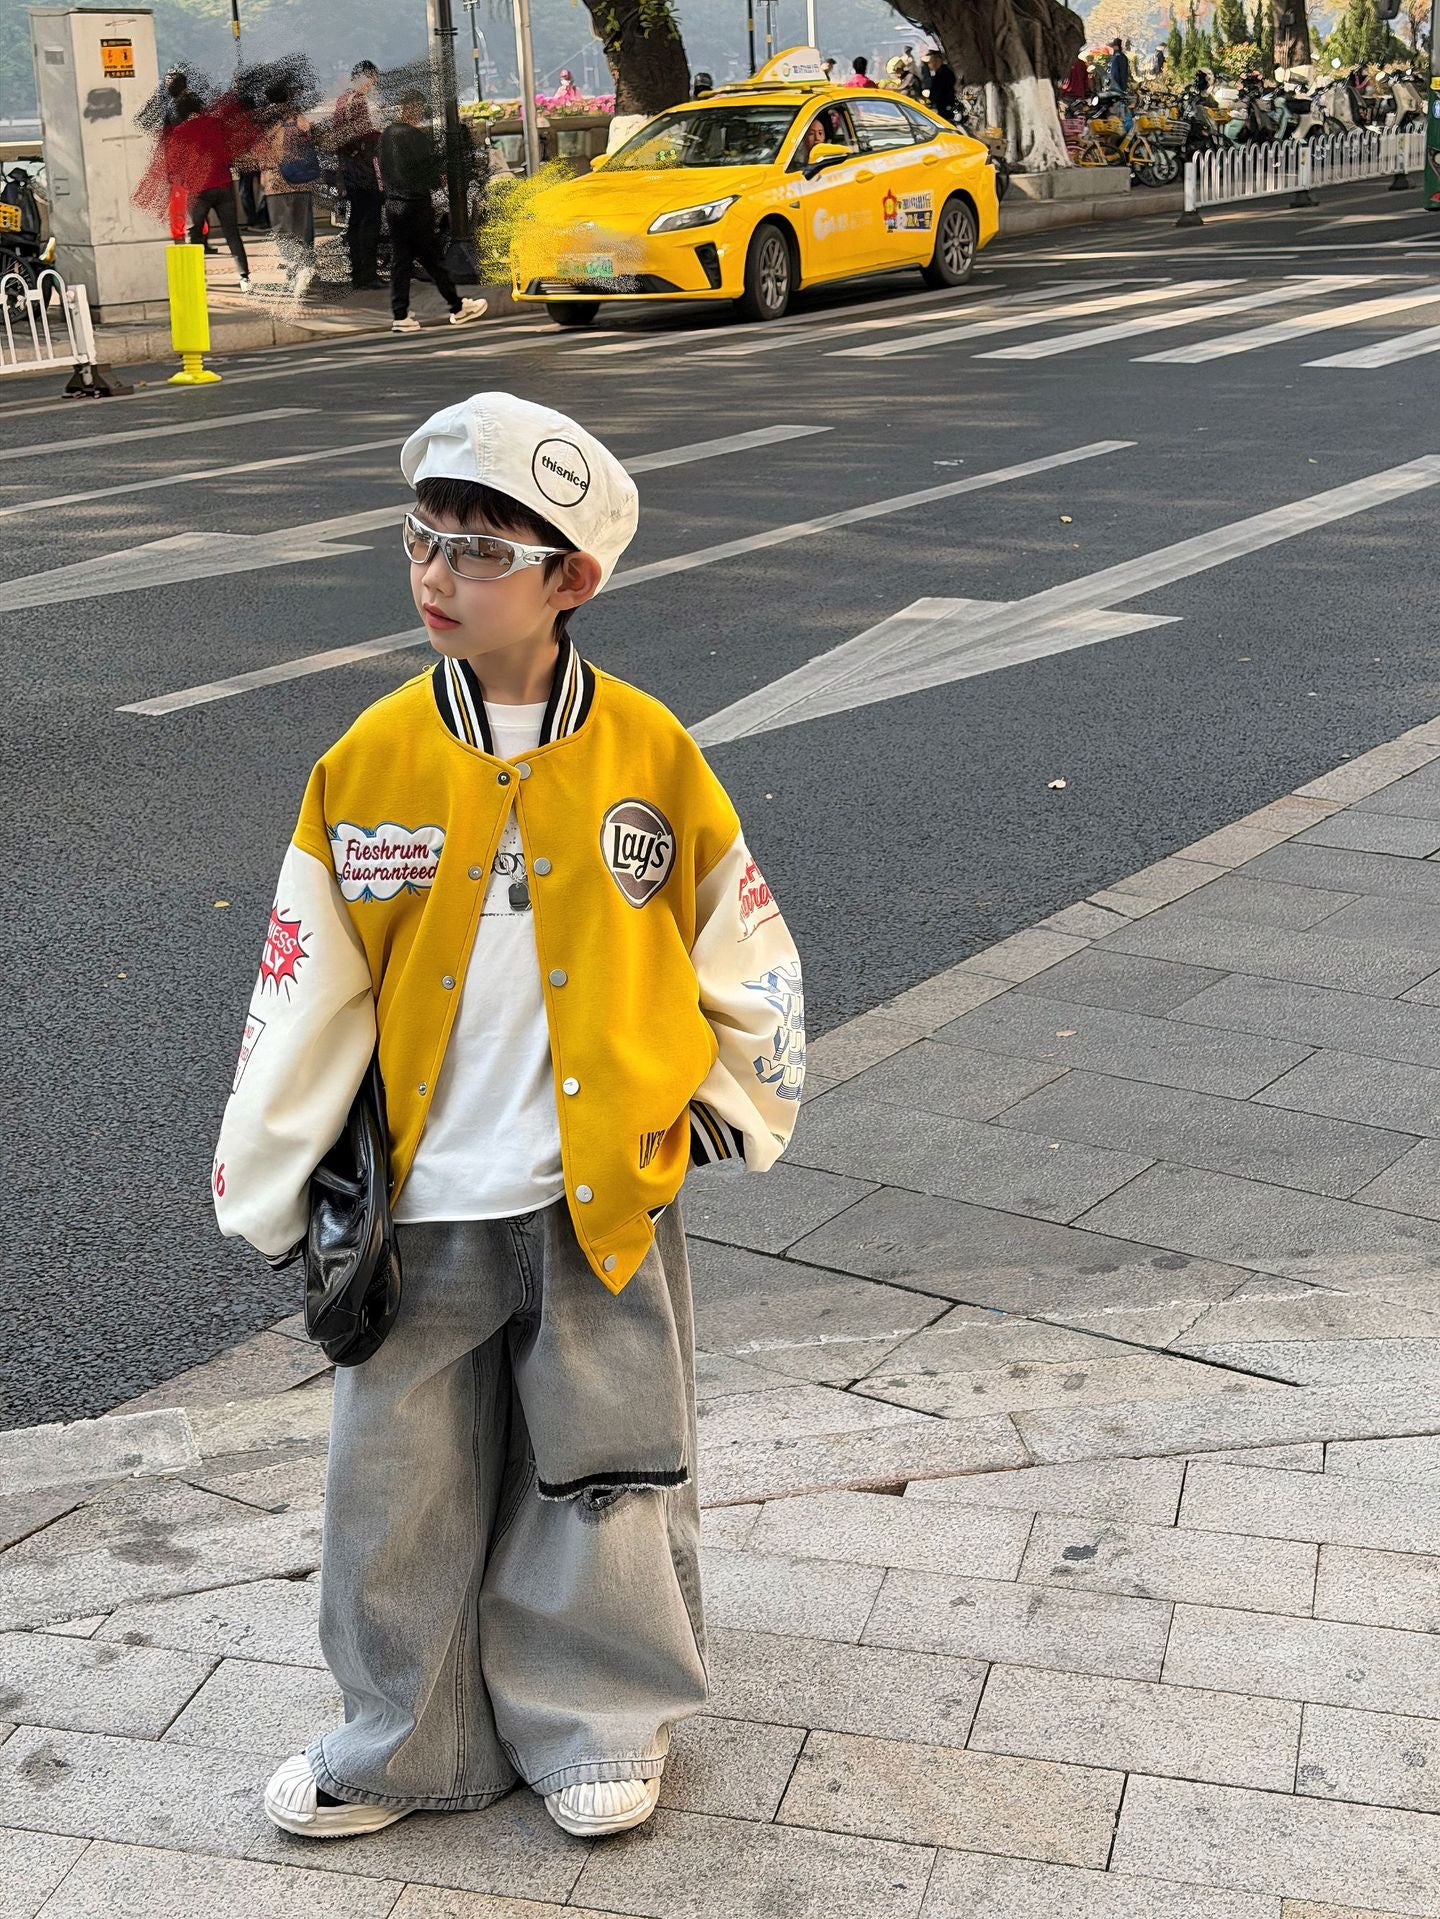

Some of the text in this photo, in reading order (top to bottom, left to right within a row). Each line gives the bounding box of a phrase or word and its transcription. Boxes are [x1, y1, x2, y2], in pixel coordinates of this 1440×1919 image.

[541, 455, 588, 491] thisnice
[342, 860, 440, 881] Guaranteed
[612, 825, 670, 880] Lay's
